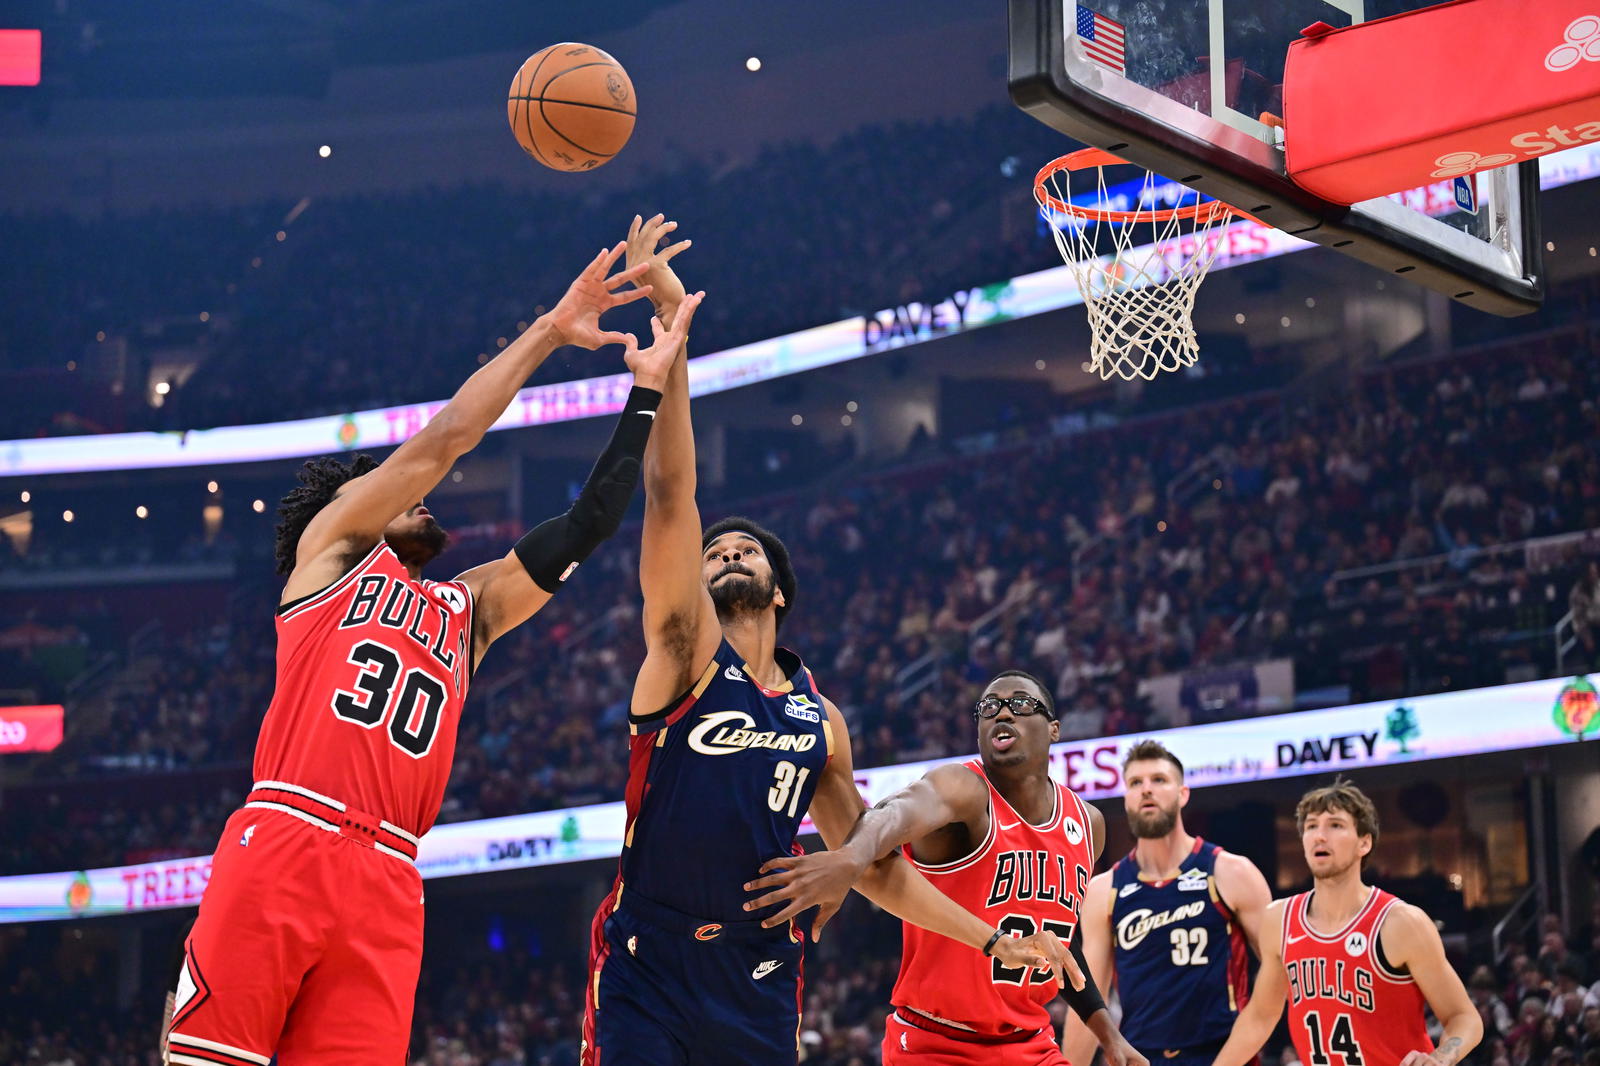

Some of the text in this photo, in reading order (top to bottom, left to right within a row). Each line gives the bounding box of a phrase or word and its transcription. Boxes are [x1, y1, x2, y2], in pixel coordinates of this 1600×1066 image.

[1457, 185, 1470, 206] NBA
[864, 288, 976, 346] DAVEY
[338, 574, 466, 698] BULLS
[330, 639, 448, 759] 30
[785, 706, 818, 721] CLIFFS
[688, 711, 817, 756] CLEVELAND
[1276, 732, 1379, 768] DAVEY
[768, 760, 811, 819] 31
[985, 850, 1088, 918] BULLS
[1116, 900, 1205, 951] CLEVELAND
[1170, 926, 1209, 966] 32
[757, 960, 777, 972] NIKE
[1286, 957, 1375, 1013] BULLS
[1303, 1010, 1366, 1066] 14
